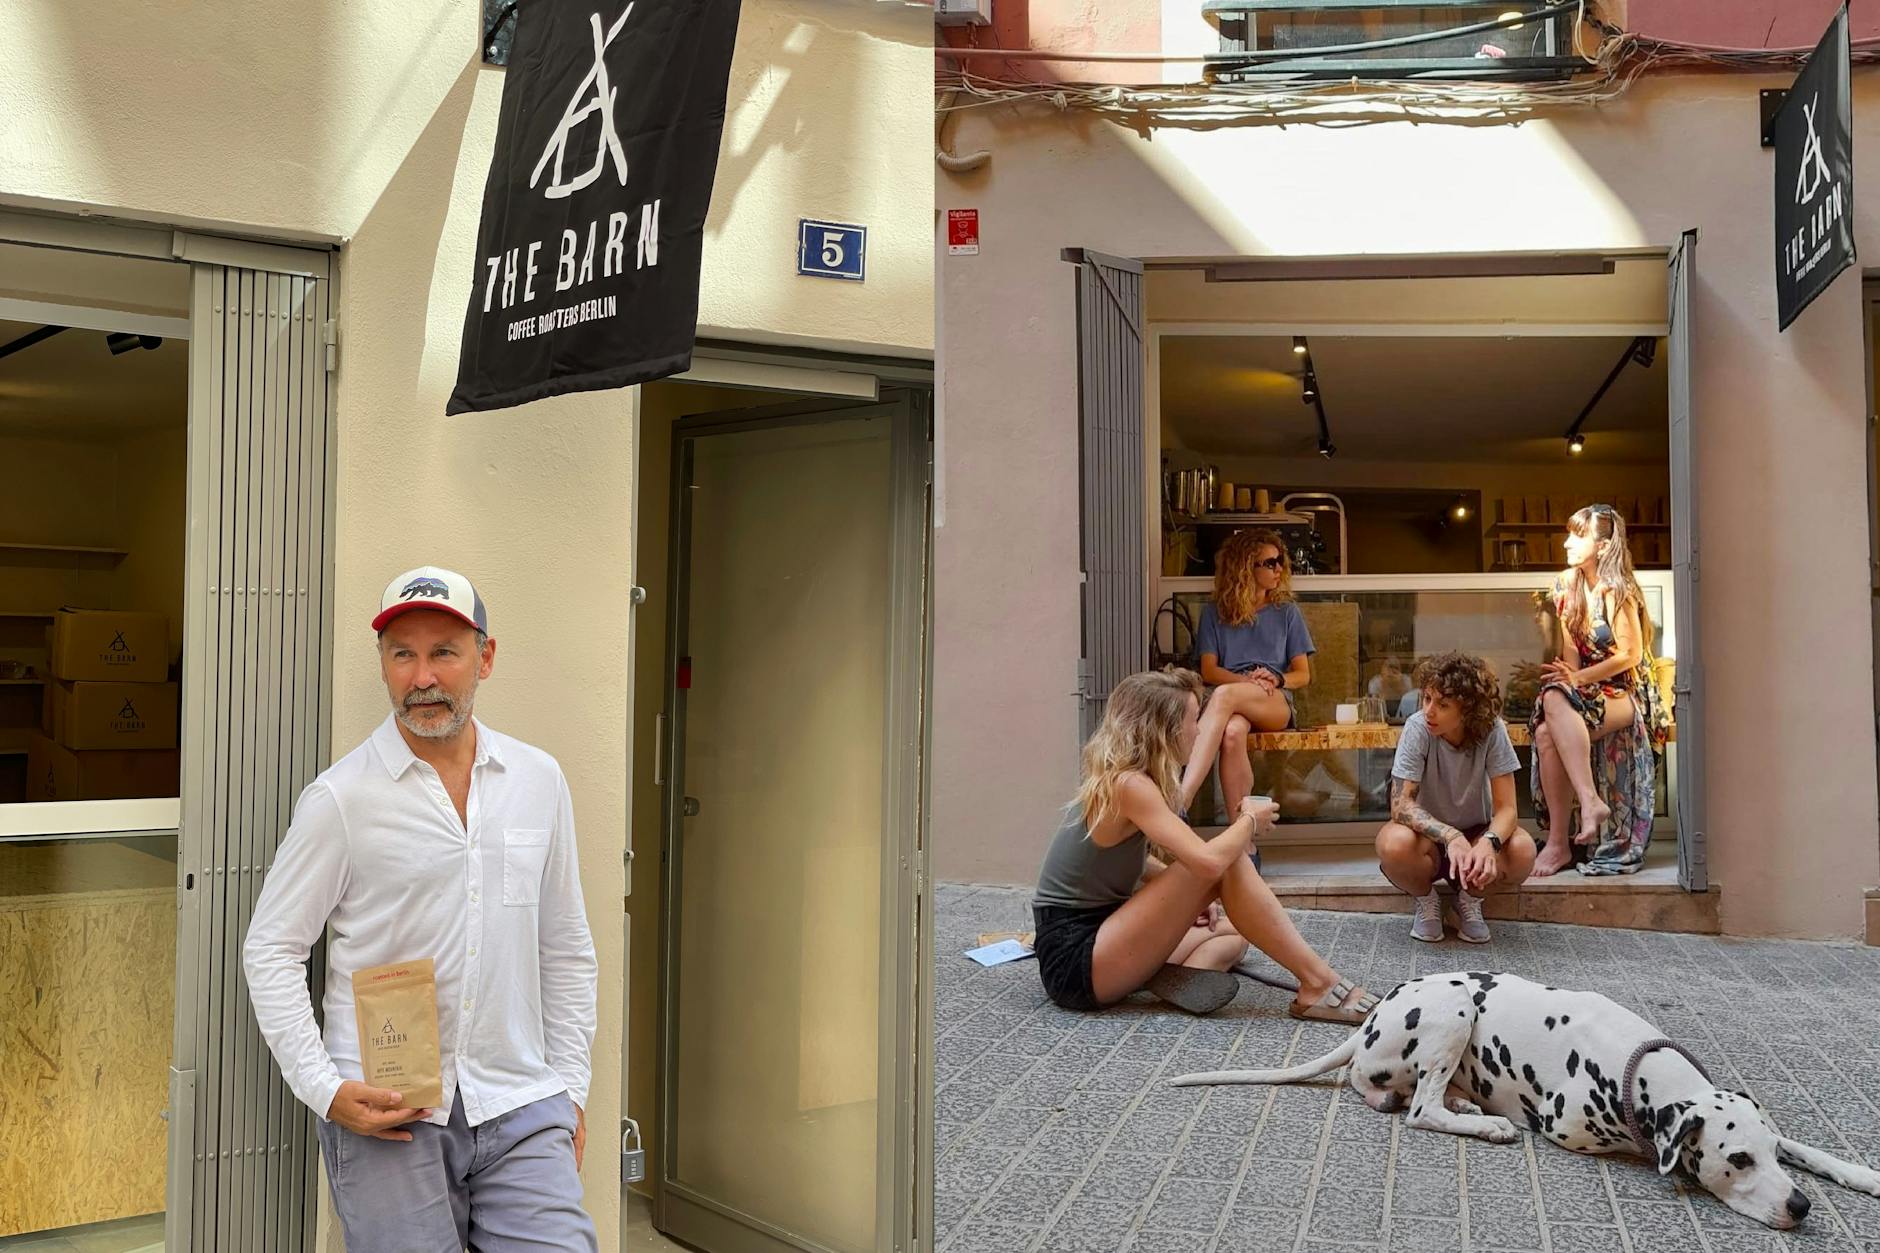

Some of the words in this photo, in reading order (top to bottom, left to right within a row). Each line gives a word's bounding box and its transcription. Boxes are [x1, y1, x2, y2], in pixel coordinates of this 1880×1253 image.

[483, 240, 542, 313] THE
[555, 199, 661, 292] BARN
[822, 231, 844, 267] 5
[1785, 226, 1805, 275] THE
[507, 317, 536, 342] COFFEE
[538, 304, 579, 335] ROASTERS
[579, 295, 616, 323] BERLIN
[372, 1036, 384, 1047] THE
[387, 1033, 408, 1044] BARN
